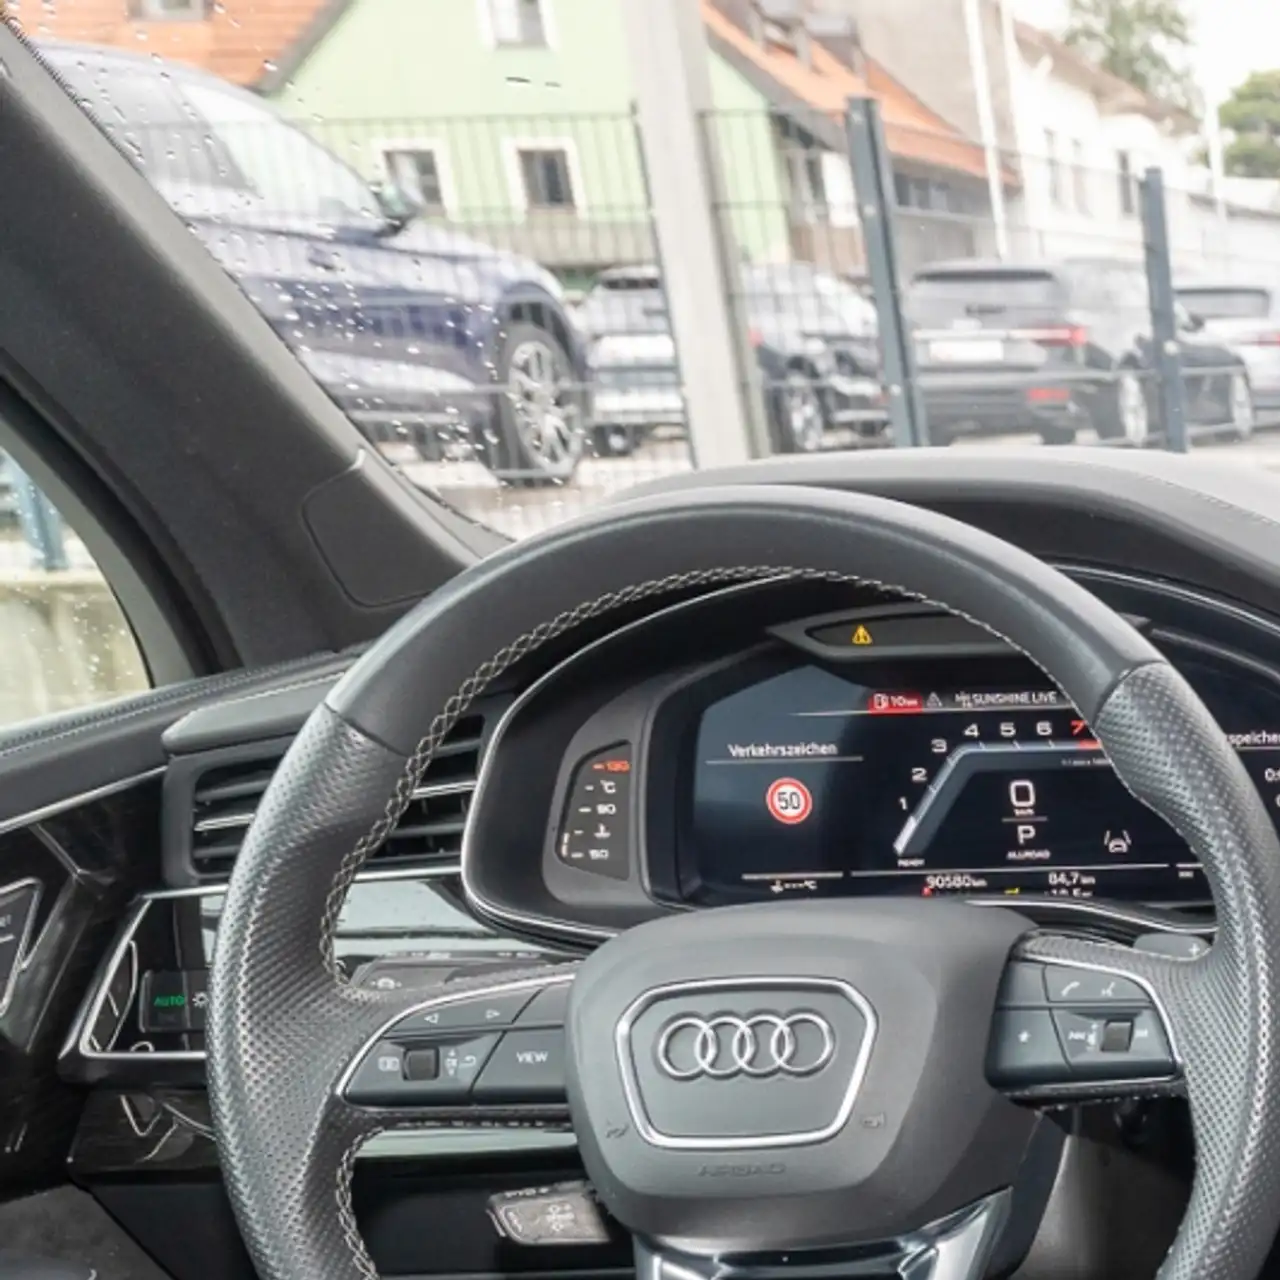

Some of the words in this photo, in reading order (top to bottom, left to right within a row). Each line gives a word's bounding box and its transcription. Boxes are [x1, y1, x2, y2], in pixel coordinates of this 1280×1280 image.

[972, 692, 1030, 705] SUNSHINE
[1032, 691, 1057, 703] LIVE
[964, 722, 980, 738] 4
[1000, 721, 1017, 737] 5
[1036, 720, 1053, 736] 6
[1070, 719, 1087, 736] 7
[727, 742, 839, 758] Verkehrszeichen
[931, 738, 948, 753] 3
[911, 767, 928, 782] 2
[776, 791, 801, 812] 50
[1009, 779, 1036, 808] 0
[898, 796, 908, 811] 1
[1017, 824, 1037, 845] P
[153, 994, 187, 1007] AUTO
[515, 1050, 549, 1064] VIEW
